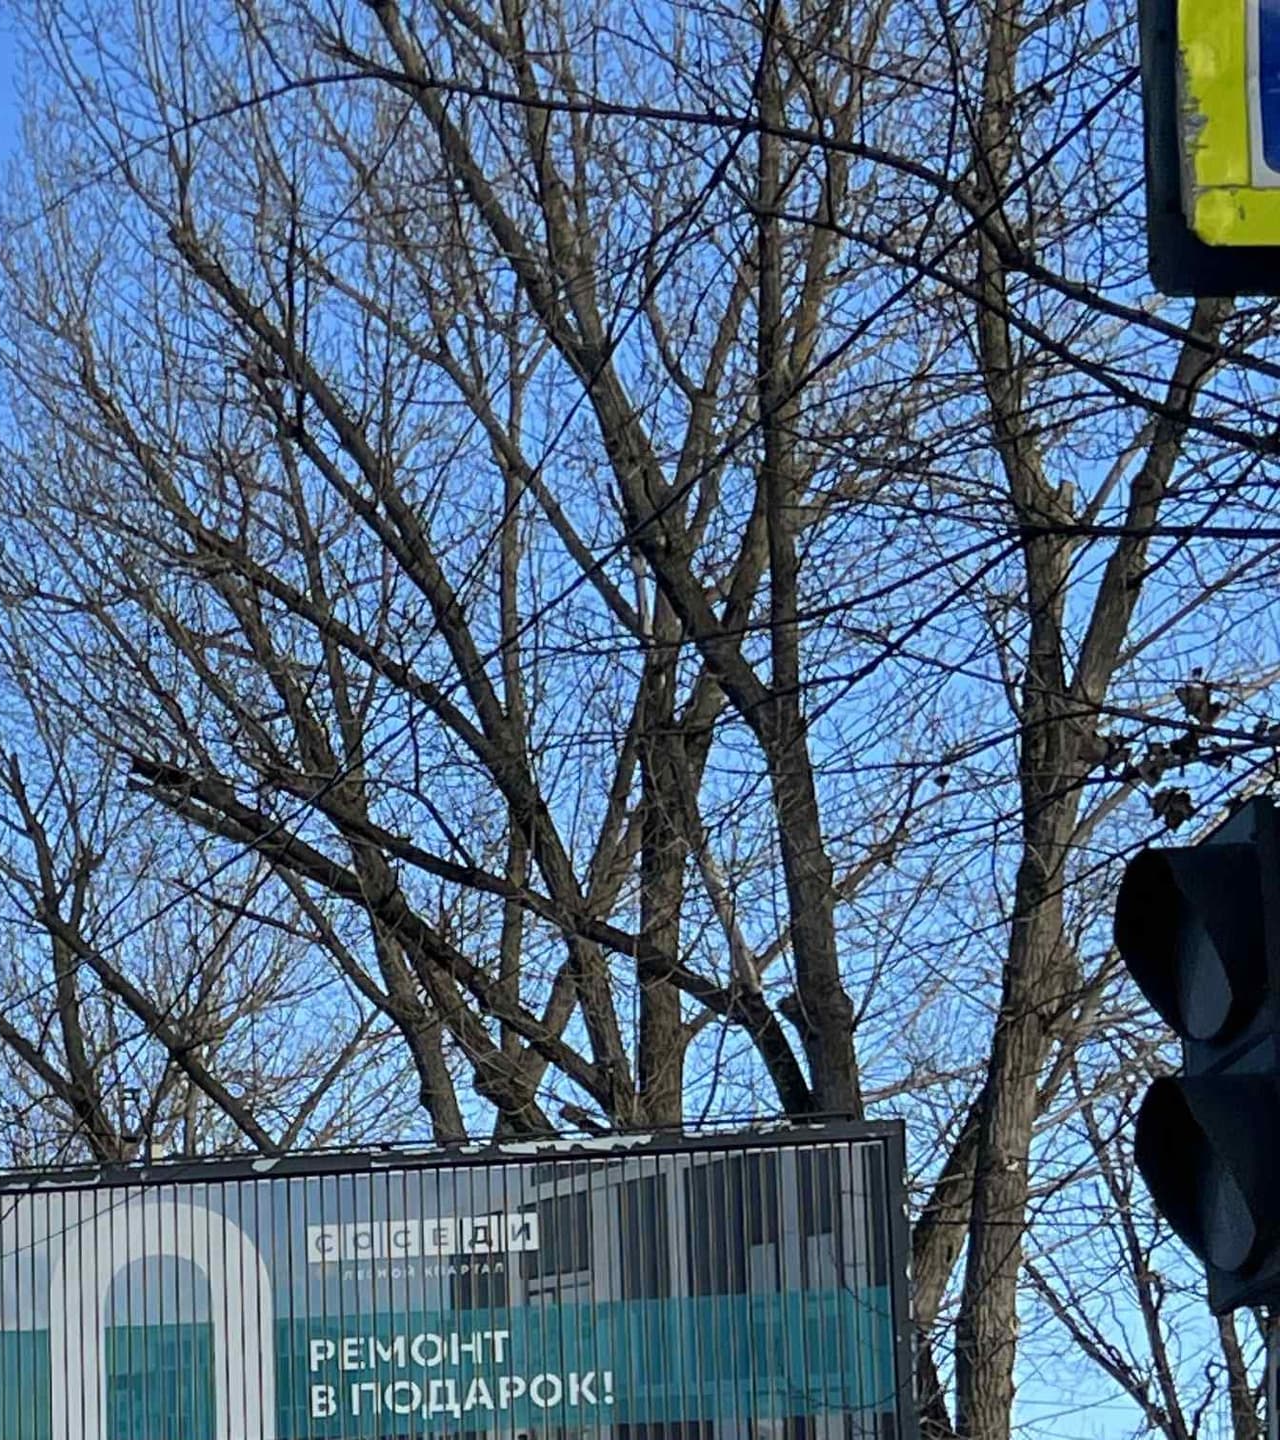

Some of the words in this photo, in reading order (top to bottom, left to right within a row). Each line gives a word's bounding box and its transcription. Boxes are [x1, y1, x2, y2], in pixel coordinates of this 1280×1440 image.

[315, 1214, 531, 1253] СОСЕДИ
[310, 1330, 509, 1372] РЕМОНТ
[311, 1384, 336, 1418] В
[352, 1371, 614, 1420] ПОДАРОК!
